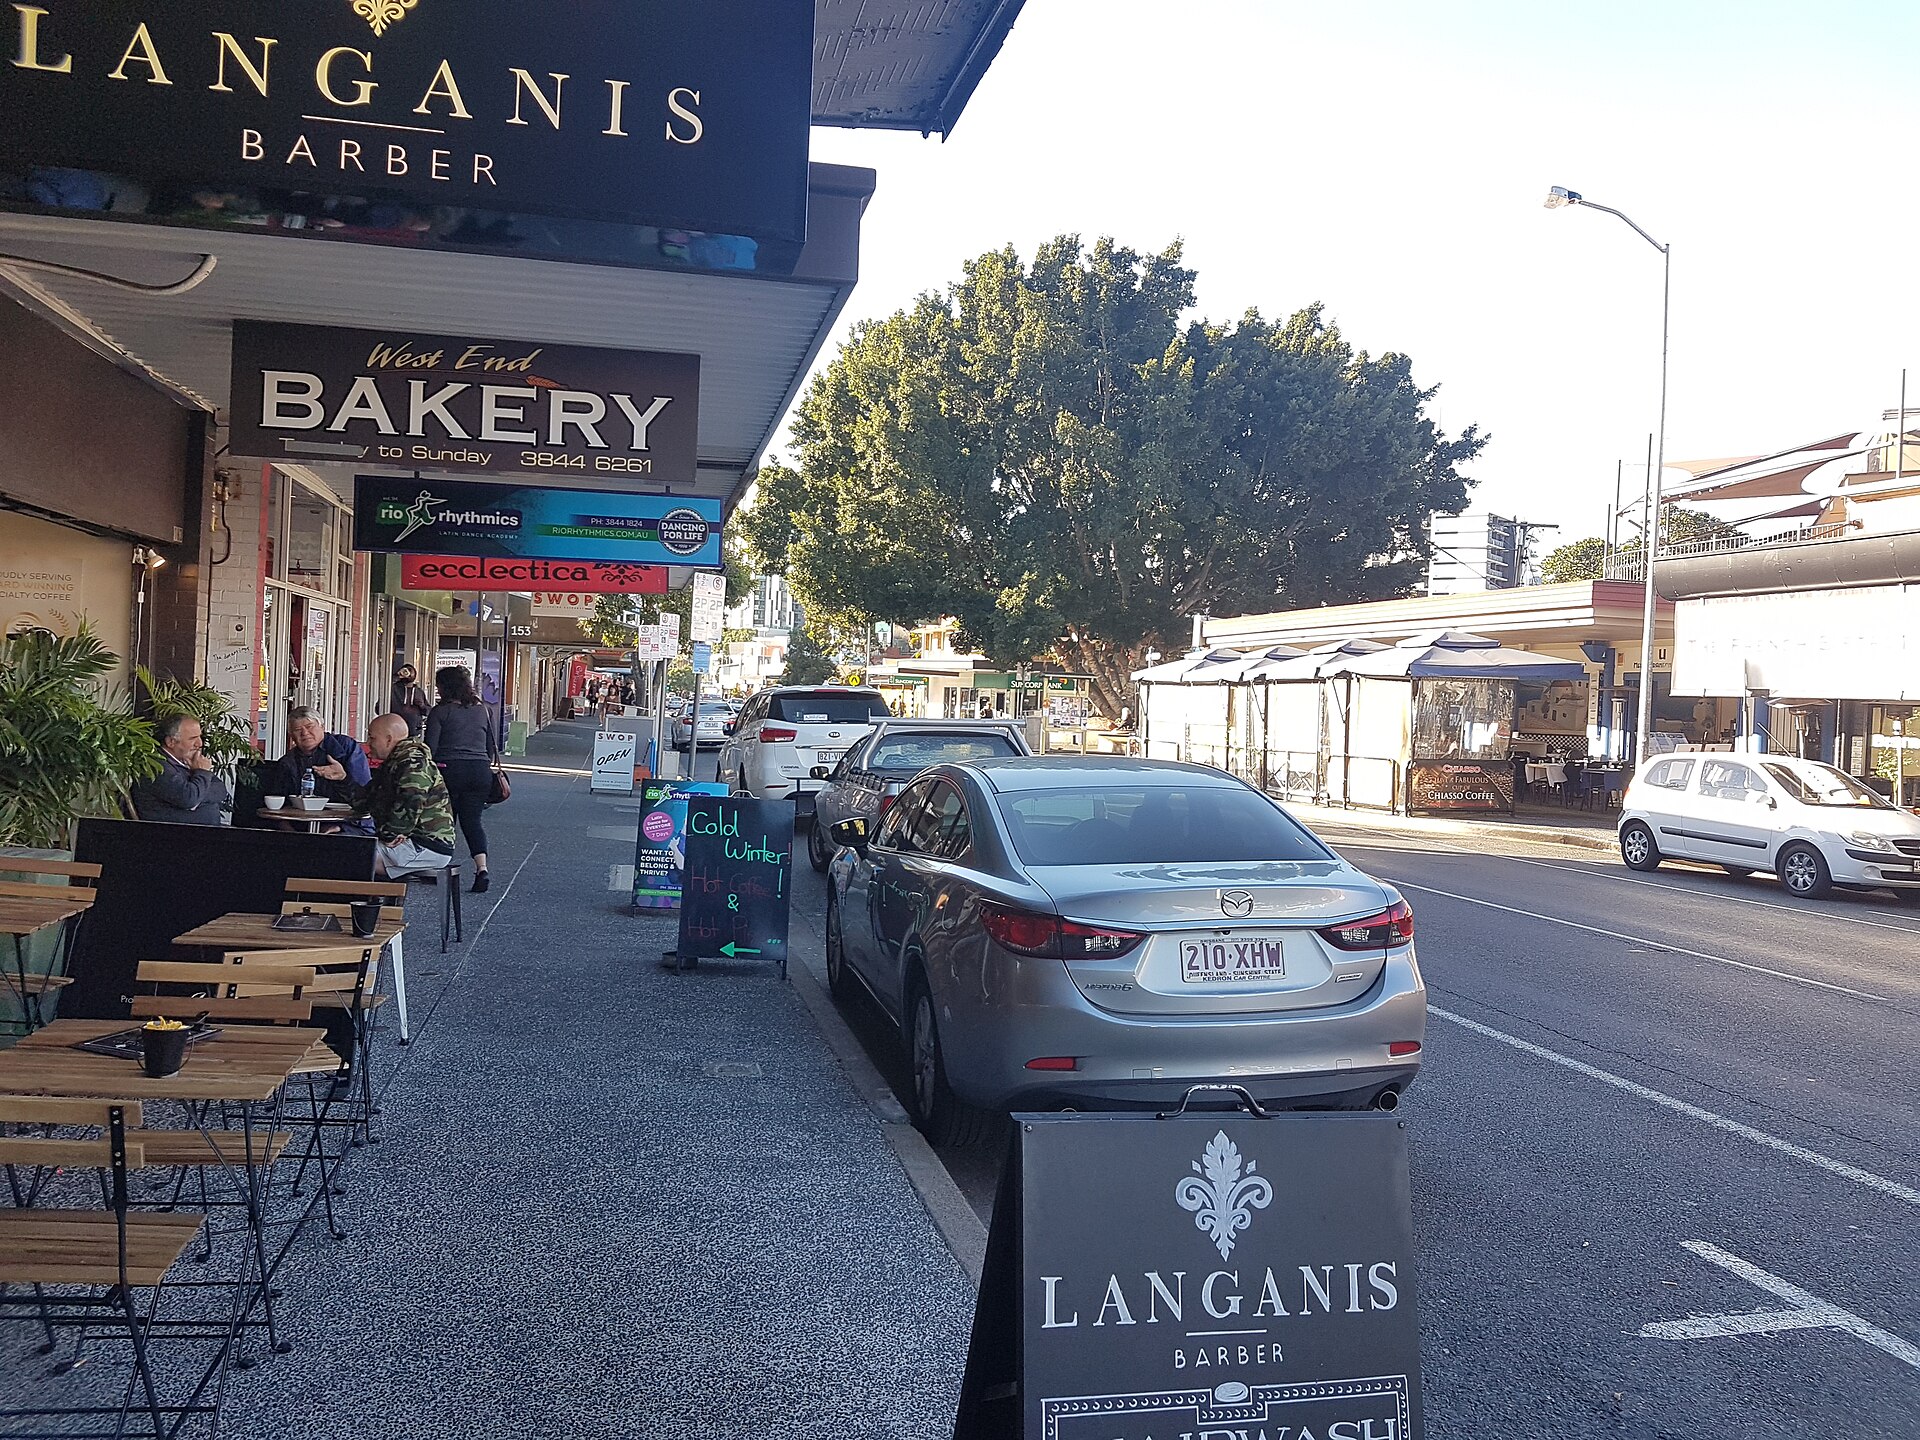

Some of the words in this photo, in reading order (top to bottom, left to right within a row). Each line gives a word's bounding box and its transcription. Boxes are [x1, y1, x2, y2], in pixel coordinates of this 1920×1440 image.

[11, 4, 705, 145] LANGANIS
[241, 128, 498, 187] BARBER
[365, 341, 445, 369] West
[454, 345, 544, 373] End
[258, 369, 673, 451] BAKERY
[378, 444, 403, 458] to
[411, 445, 492, 466] Sunday
[520, 451, 586, 469] 3844
[595, 456, 652, 473] 6261
[381, 504, 403, 519] rio
[438, 509, 519, 527] rhythmics
[605, 518, 625, 527] 3844
[626, 519, 643, 528] 1824
[661, 522, 706, 533] DANCING
[552, 526, 649, 539] RIORHYTHMICS.COM.AU
[663, 531, 682, 540] FOR
[684, 532, 703, 541] LIFE
[419, 558, 591, 581] ecclectica
[29, 572, 72, 582] SERVING
[21, 582, 74, 592] WINNING
[33, 592, 72, 601] COFFEE
[533, 592, 594, 606] SWOP
[694, 597, 708, 609] 2P
[709, 599, 723, 611] 2P
[511, 625, 531, 636] 153
[597, 732, 634, 742] SWOP
[596, 748, 632, 766] OPEN
[1455, 776, 1489, 784] FABULOUS
[1427, 791, 1463, 800] CHIASSO
[1465, 791, 1495, 800] COFFEE
[691, 806, 739, 838] Cold
[641, 848, 662, 856] WANT
[640, 855, 676, 864] CONNECT,
[640, 862, 669, 870] BELONG
[691, 865, 723, 894] Hot
[727, 893, 739, 912] &
[1187, 971, 1227, 979] QUEENSLAND
[1040, 1260, 1399, 1329] LANGANIS
[1174, 1343, 1284, 1370] BARBER
